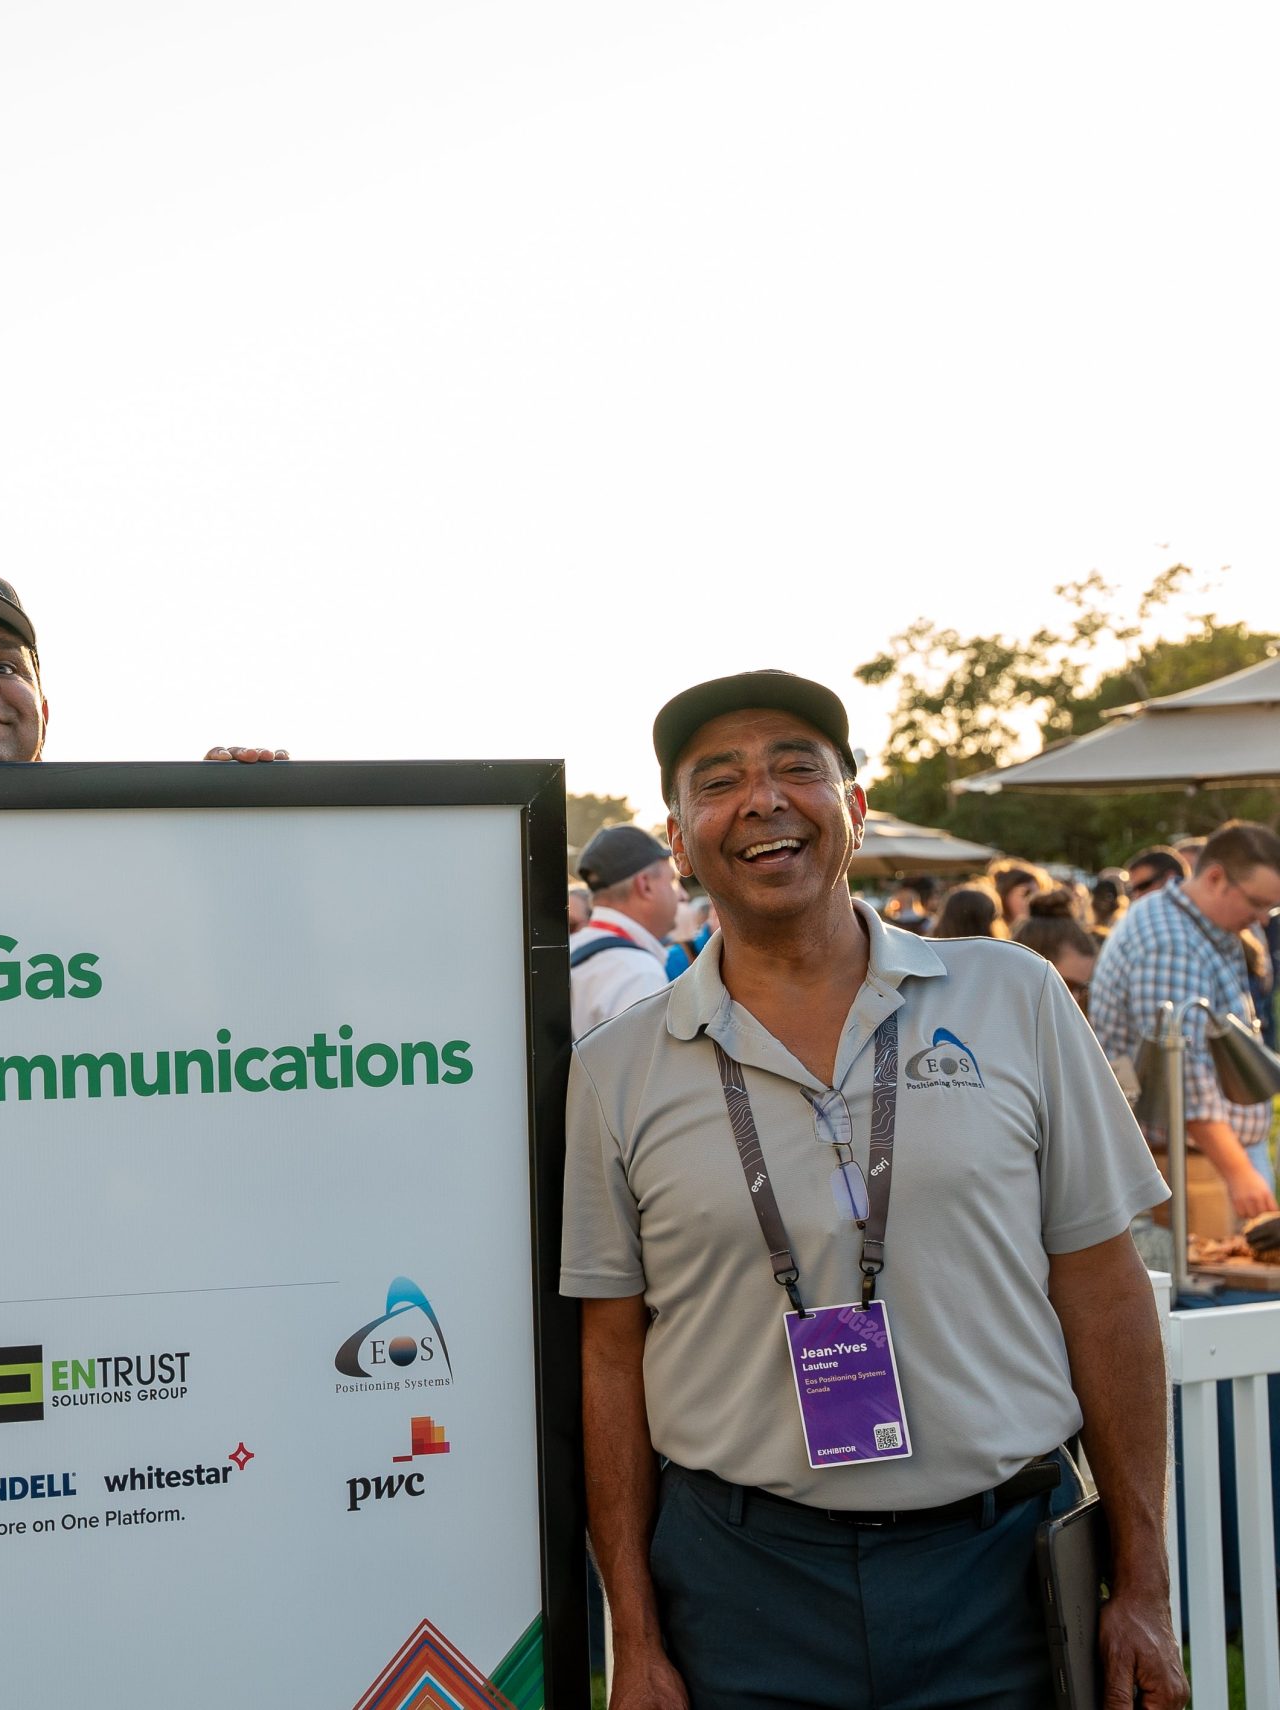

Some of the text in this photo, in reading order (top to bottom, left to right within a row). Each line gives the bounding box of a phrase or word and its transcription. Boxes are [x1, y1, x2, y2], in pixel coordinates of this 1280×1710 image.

[925, 1056, 970, 1076] EOS
[906, 1079, 983, 1090] Positioning Systems
[870, 1157, 890, 1177] esri
[751, 1171, 767, 1193] esri
[369, 1335, 434, 1367] EOS
[800, 1343, 868, 1360] Jean-Yves
[51, 1352, 191, 1392] ENTRUST
[802, 1360, 839, 1372] Lauture
[334, 1377, 450, 1394] Positioning Systems
[804, 1369, 887, 1386] Eos Positioning Systems
[51, 1384, 187, 1408] SOLUTIONS GROUP
[806, 1385, 831, 1395] Canada
[817, 1445, 857, 1457] EXHIBITOR
[104, 1465, 232, 1492] whitestar
[347, 1473, 424, 1511] pwc
[33, 1520, 54, 1532] on
[62, 1514, 99, 1530] One
[106, 1508, 185, 1526] Platform.
